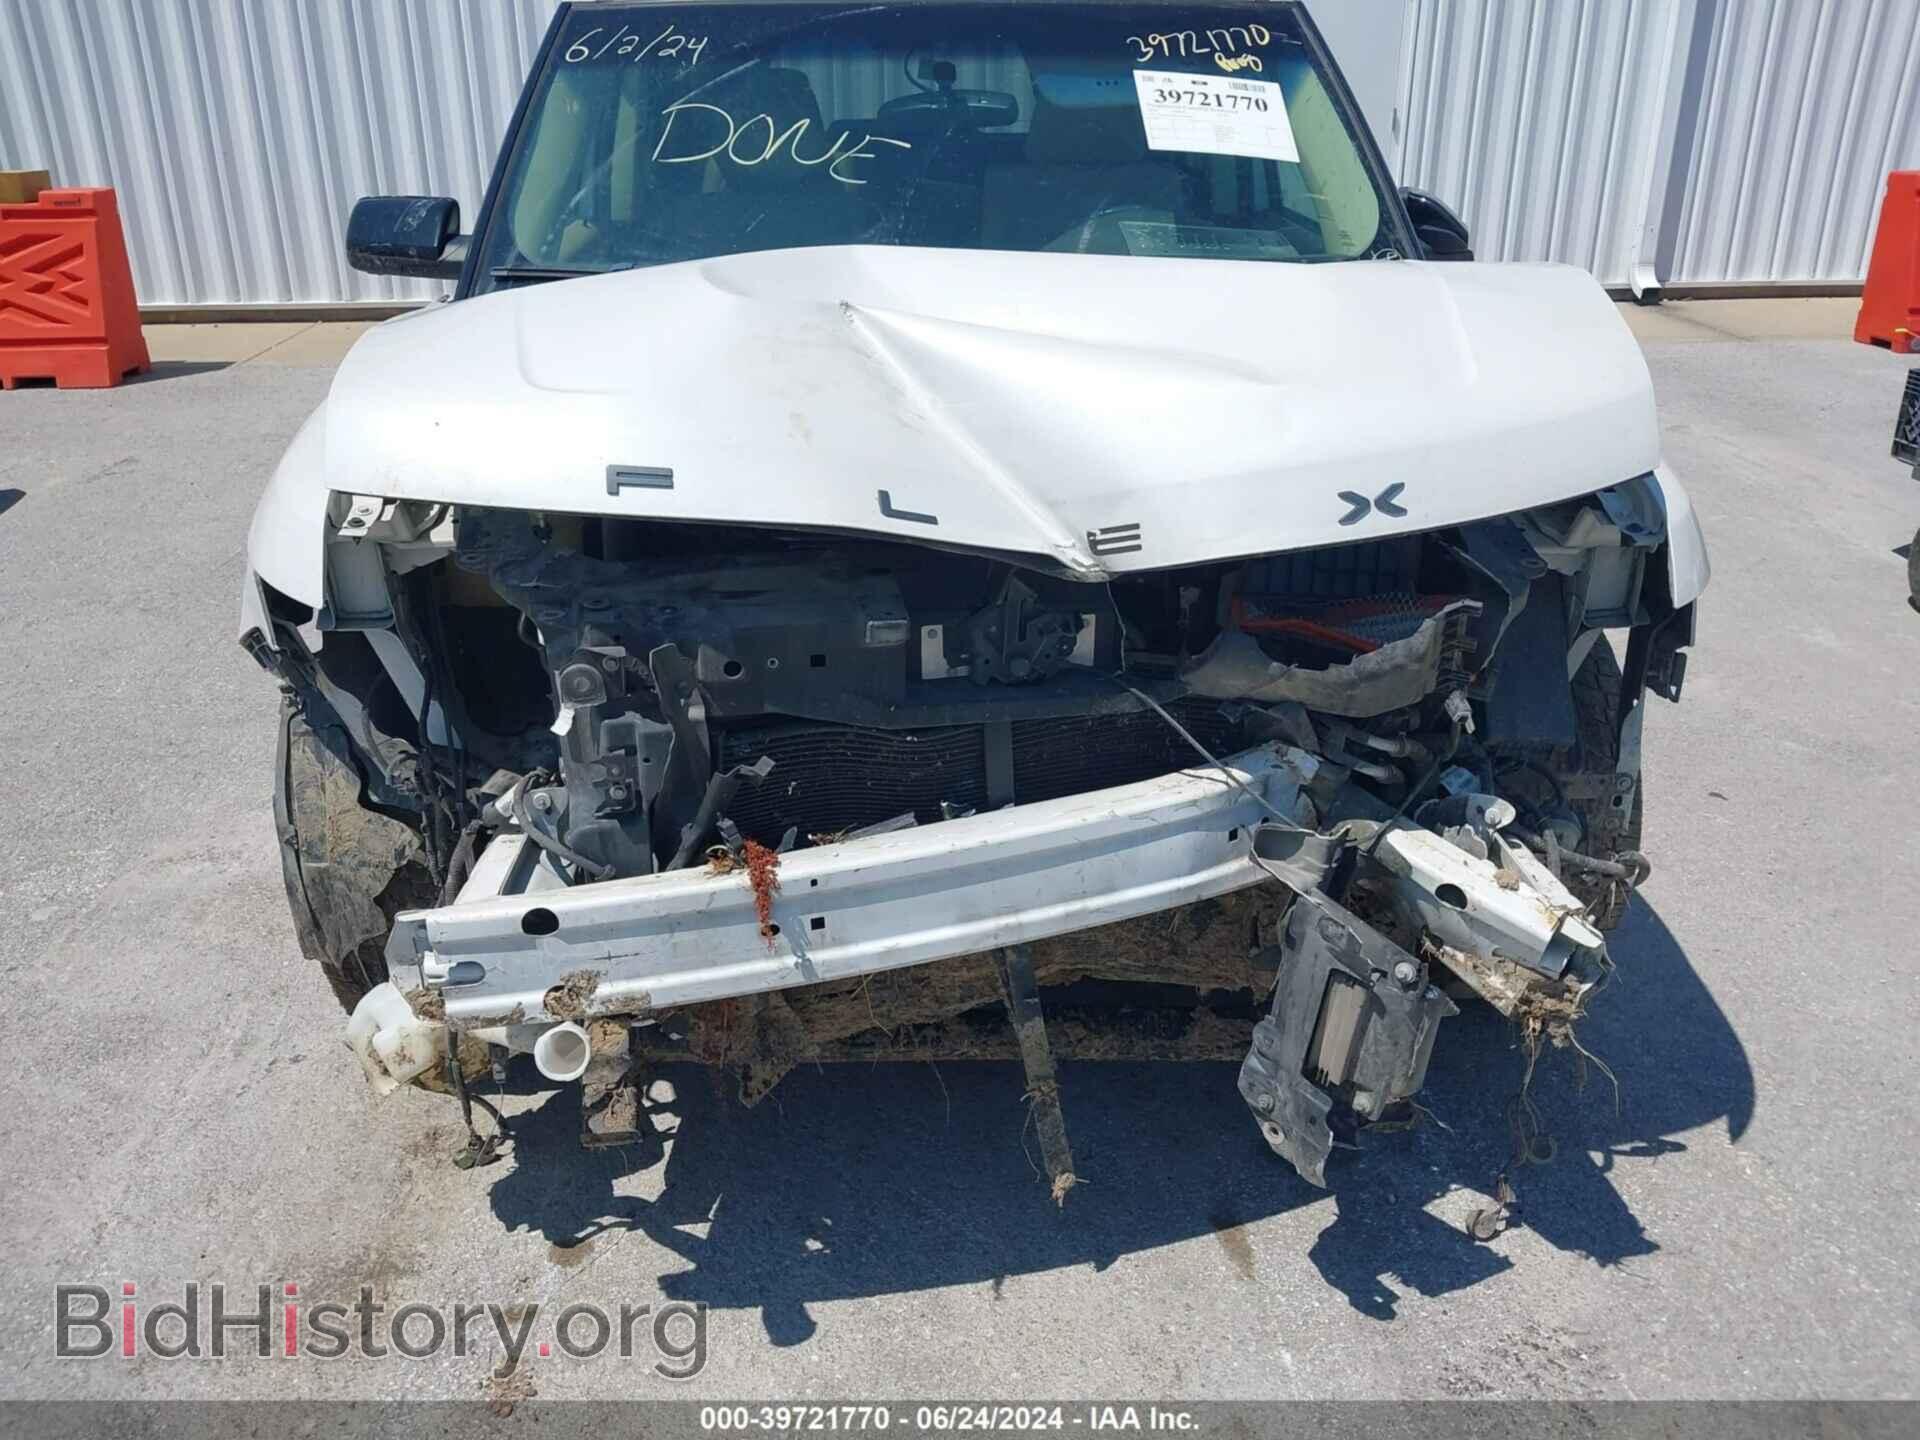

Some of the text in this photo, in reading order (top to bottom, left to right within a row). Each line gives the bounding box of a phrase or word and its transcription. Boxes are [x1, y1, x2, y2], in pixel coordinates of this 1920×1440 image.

[564, 25, 708, 64] 6/2/24
[1126, 24, 1270, 62] 39721770
[1153, 88, 1269, 113] 39721770
[652, 103, 912, 184] DONE
